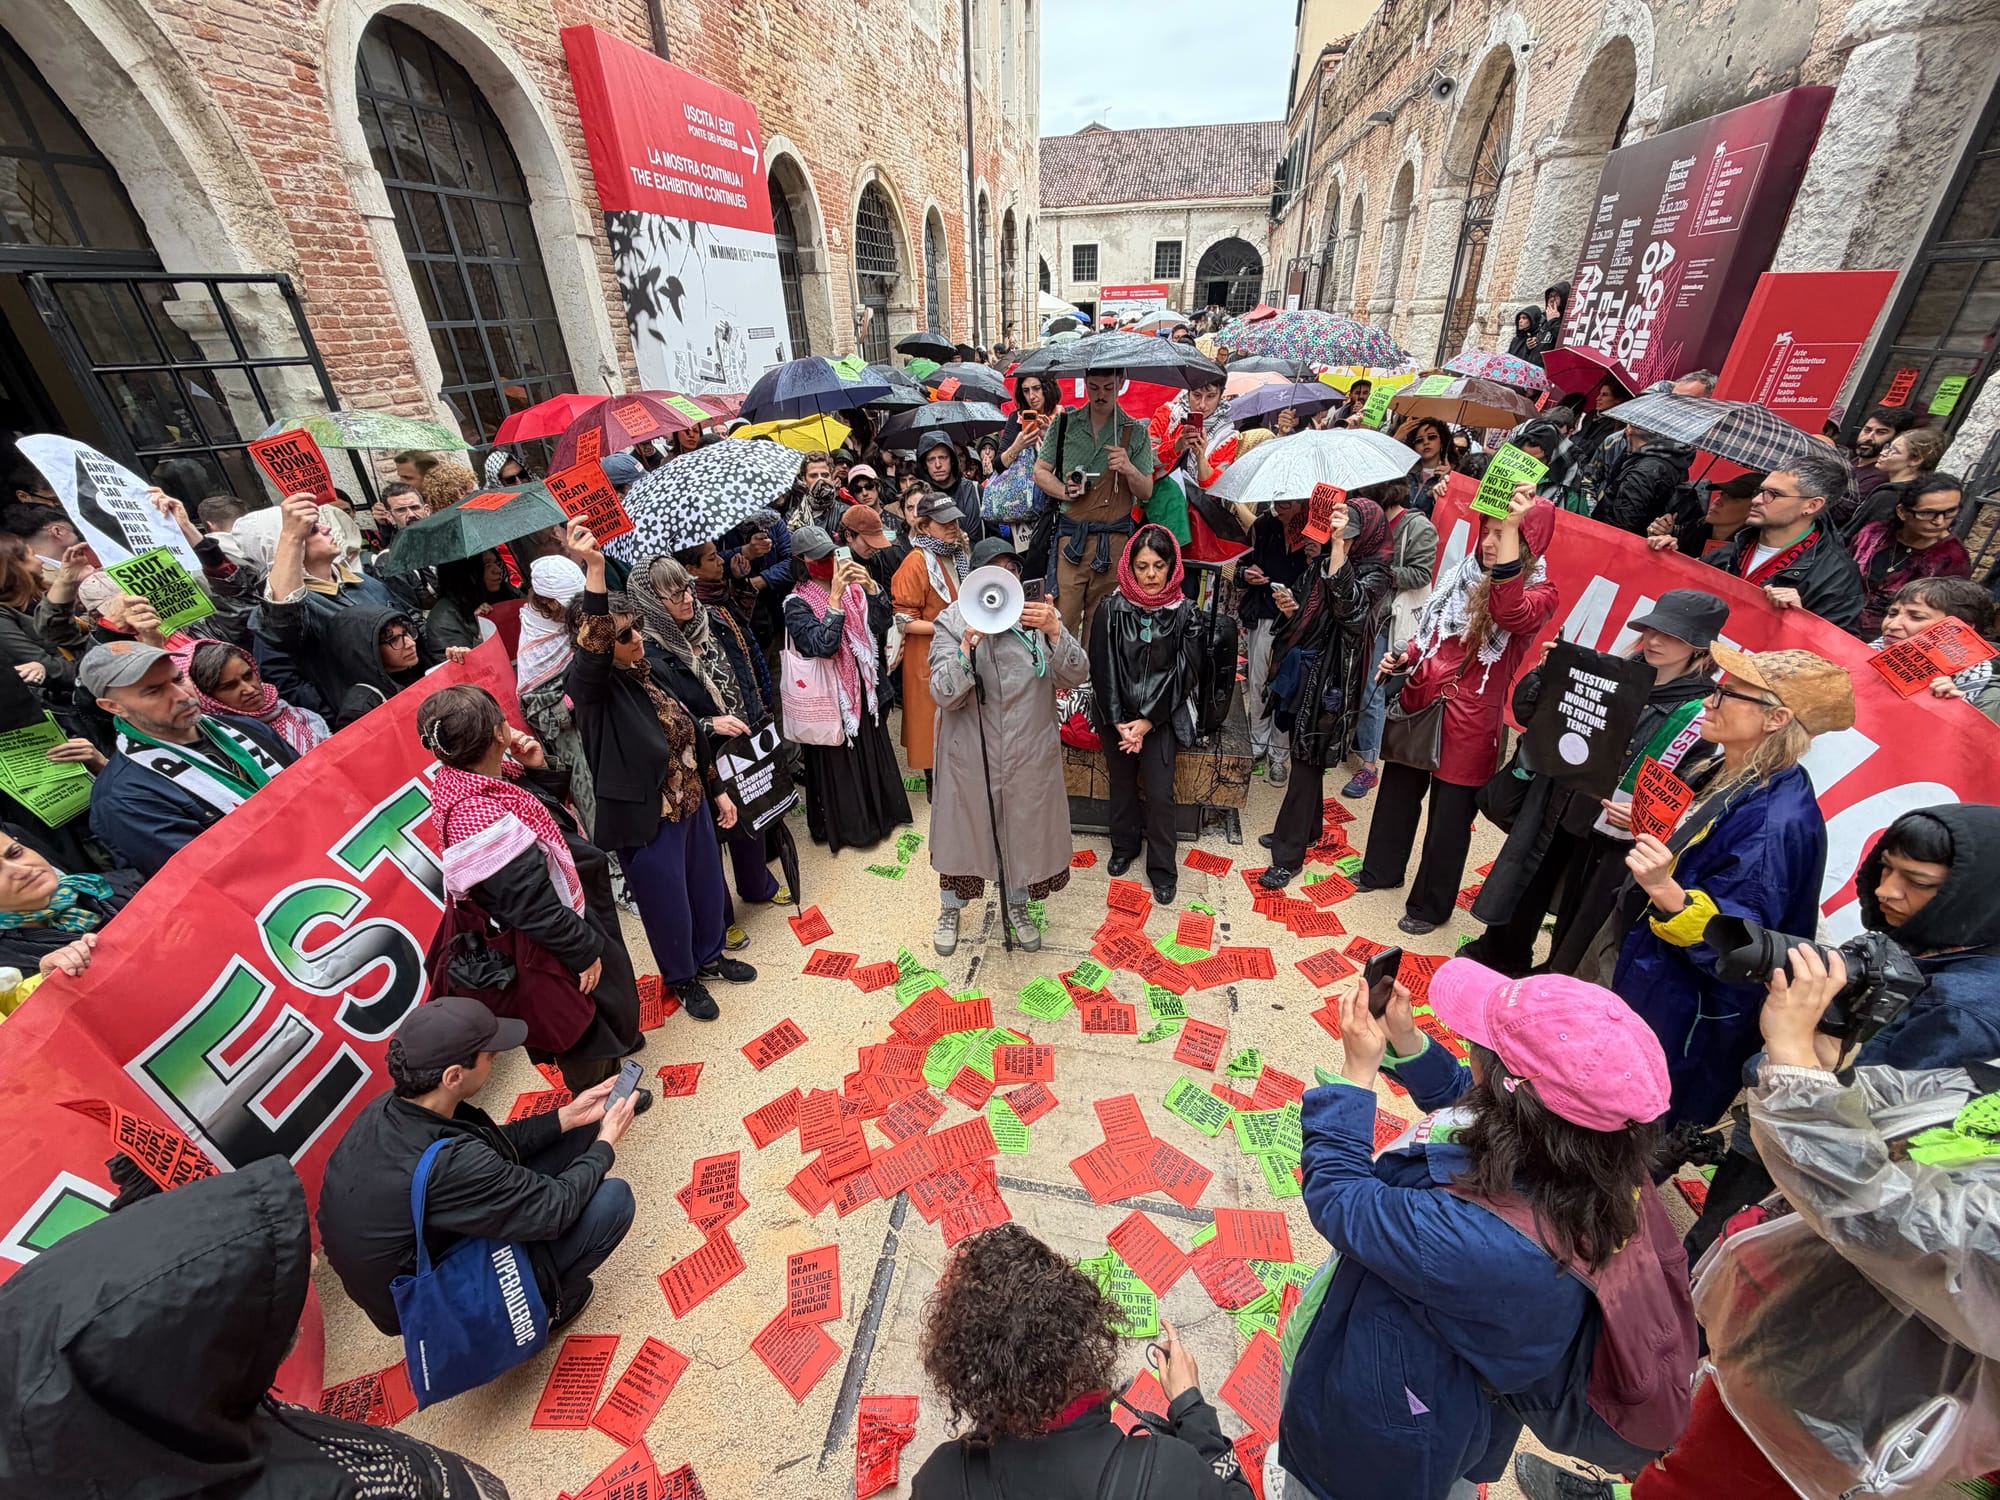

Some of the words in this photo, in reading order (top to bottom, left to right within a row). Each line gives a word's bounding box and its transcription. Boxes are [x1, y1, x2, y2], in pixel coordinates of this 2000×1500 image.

[683, 103, 714, 129] USCITA
[719, 118, 735, 136] EXIT
[647, 146, 662, 165] LA
[662, 151, 701, 177] MOSTRA
[630, 167, 653, 187] THE
[653, 172, 704, 199] EXHIBITION
[704, 185, 748, 208] CONTINUES
[709, 244, 718, 259] IN
[718, 245, 738, 261] MINOR
[738, 247, 753, 262] KEYS
[1655, 239, 1676, 274] A
[1637, 241, 1661, 298] OF
[1617, 303, 1642, 368] SO
[1626, 279, 1665, 381] CHIL
[261, 440, 302, 462] SHUT
[1503, 448, 1521, 460] CAN
[1521, 456, 1538, 470] YOU
[86, 462, 117, 475] ANGRY
[269, 450, 317, 475] DOWN
[1492, 465, 1516, 479] THIS?
[1498, 456, 1539, 479] TOLERATE
[92, 474, 112, 486] WE
[279, 472, 299, 485] THE
[299, 465, 323, 479] 2026
[286, 473, 328, 493] GENOCIDE
[551, 479, 567, 493] NO
[1485, 476, 1498, 486] NO
[1499, 479, 1510, 490] TO
[101, 487, 122, 498] SAD
[558, 481, 590, 503] DEATH
[566, 504, 579, 515] IN
[577, 487, 609, 509] VENICE
[1314, 485, 1339, 500] SHUT
[1482, 485, 1514, 501] GENOCI
[107, 499, 124, 510] WE
[589, 506, 600, 518] TO
[600, 498, 618, 513] THE
[116, 511, 148, 522] UNITED
[124, 523, 143, 534] FOR
[592, 519, 622, 539] VILION
[129, 535, 154, 546] FREE
[116, 556, 167, 584] SHUT
[128, 566, 183, 597] DOWN
[149, 591, 162, 605] HE
[162, 580, 190, 595] 2026
[154, 587, 197, 613] ENOCIDE
[160, 597, 199, 621] AVILION
[1932, 625, 1970, 657] CULTURAL
[1881, 653, 1916, 684] PAVILION
[1889, 648, 1929, 681] GENOCIDE
[1899, 642, 1914, 655] NO
[1911, 652, 1924, 663] TO
[1921, 660, 1940, 676] THE
[1569, 666, 1619, 694] PALESTINE
[1574, 682, 1585, 695] IS
[1585, 687, 1603, 702] THE
[1564, 691, 1596, 713] WORLD
[1595, 704, 1608, 718] IN
[1557, 701, 1574, 716] ITS
[1573, 708, 1607, 731] FUTURE
[1566, 716, 1593, 738] TENSE
[734, 773, 745, 783] TO
[737, 762, 776, 790] OCCUPATION
[1645, 763, 1664, 783] CAN
[1663, 776, 1683, 797] YOU
[742, 781, 773, 805] GENOCIDE
[1636, 786, 1655, 809] THIS?
[1640, 775, 1683, 812] TOLERATE
[1639, 806, 1649, 820] TO
[1648, 815, 1667, 836] THE
[1152, 1000, 1183, 1010] DOWN
[1158, 1008, 1186, 1017] SHUT
[1201, 1060, 1213, 1068] NO
[1014, 1086, 1046, 1111] GENOCIDE
[1018, 1094, 1048, 1118] PAVILION
[1173, 1083, 1195, 1107] PAVILION
[1182, 1087, 1202, 1116] GENOCIDE
[1194, 1096, 1220, 1126] DOWN
[1207, 1102, 1230, 1130] SHUT
[1257, 1114, 1266, 1127] THE
[1288, 1105, 1300, 1114] NO
[120, 1115, 137, 1147] END
[882, 1116, 909, 1140] PAVILION
[1241, 1114, 1259, 1146] PAVILION
[1249, 1113, 1268, 1149] GENOCIDE
[155, 1133, 180, 1177] NOW.
[705, 1160, 737, 1172] PAVILION
[1274, 1154, 1290, 1176] VENICE
[173, 1159, 194, 1185] NO
[701, 1166, 736, 1180] GENOCIDE
[714, 1175, 724, 1183] TO
[725, 1173, 736, 1181] NO
[1166, 1164, 1184, 1190] VENICE
[1183, 1165, 1200, 1187] DEATH
[1199, 1170, 1209, 1182] NO
[1267, 1155, 1287, 1185] BIENNALE
[696, 1184, 725, 1198] VENICE
[700, 1179, 713, 1187] THE
[726, 1181, 735, 1191] IN
[709, 1191, 735, 1205] DEATH
[723, 1200, 735, 1210] NO
[791, 1256, 803, 1266] NO
[791, 1262, 818, 1276] DEATH
[791, 1278, 800, 1288] IN
[802, 1269, 833, 1285] VENICE
[491, 1244, 538, 1348] HYPERALLERGIC
[791, 1289, 802, 1300] NO
[805, 1286, 815, 1296] TO
[817, 1282, 831, 1292] THE
[791, 1291, 831, 1308] GENOCIDE
[1122, 1293, 1134, 1304] TO
[1135, 1294, 1152, 1305] THE
[791, 1301, 828, 1317] PAVILION
[1126, 1305, 1153, 1317] OCIDE
